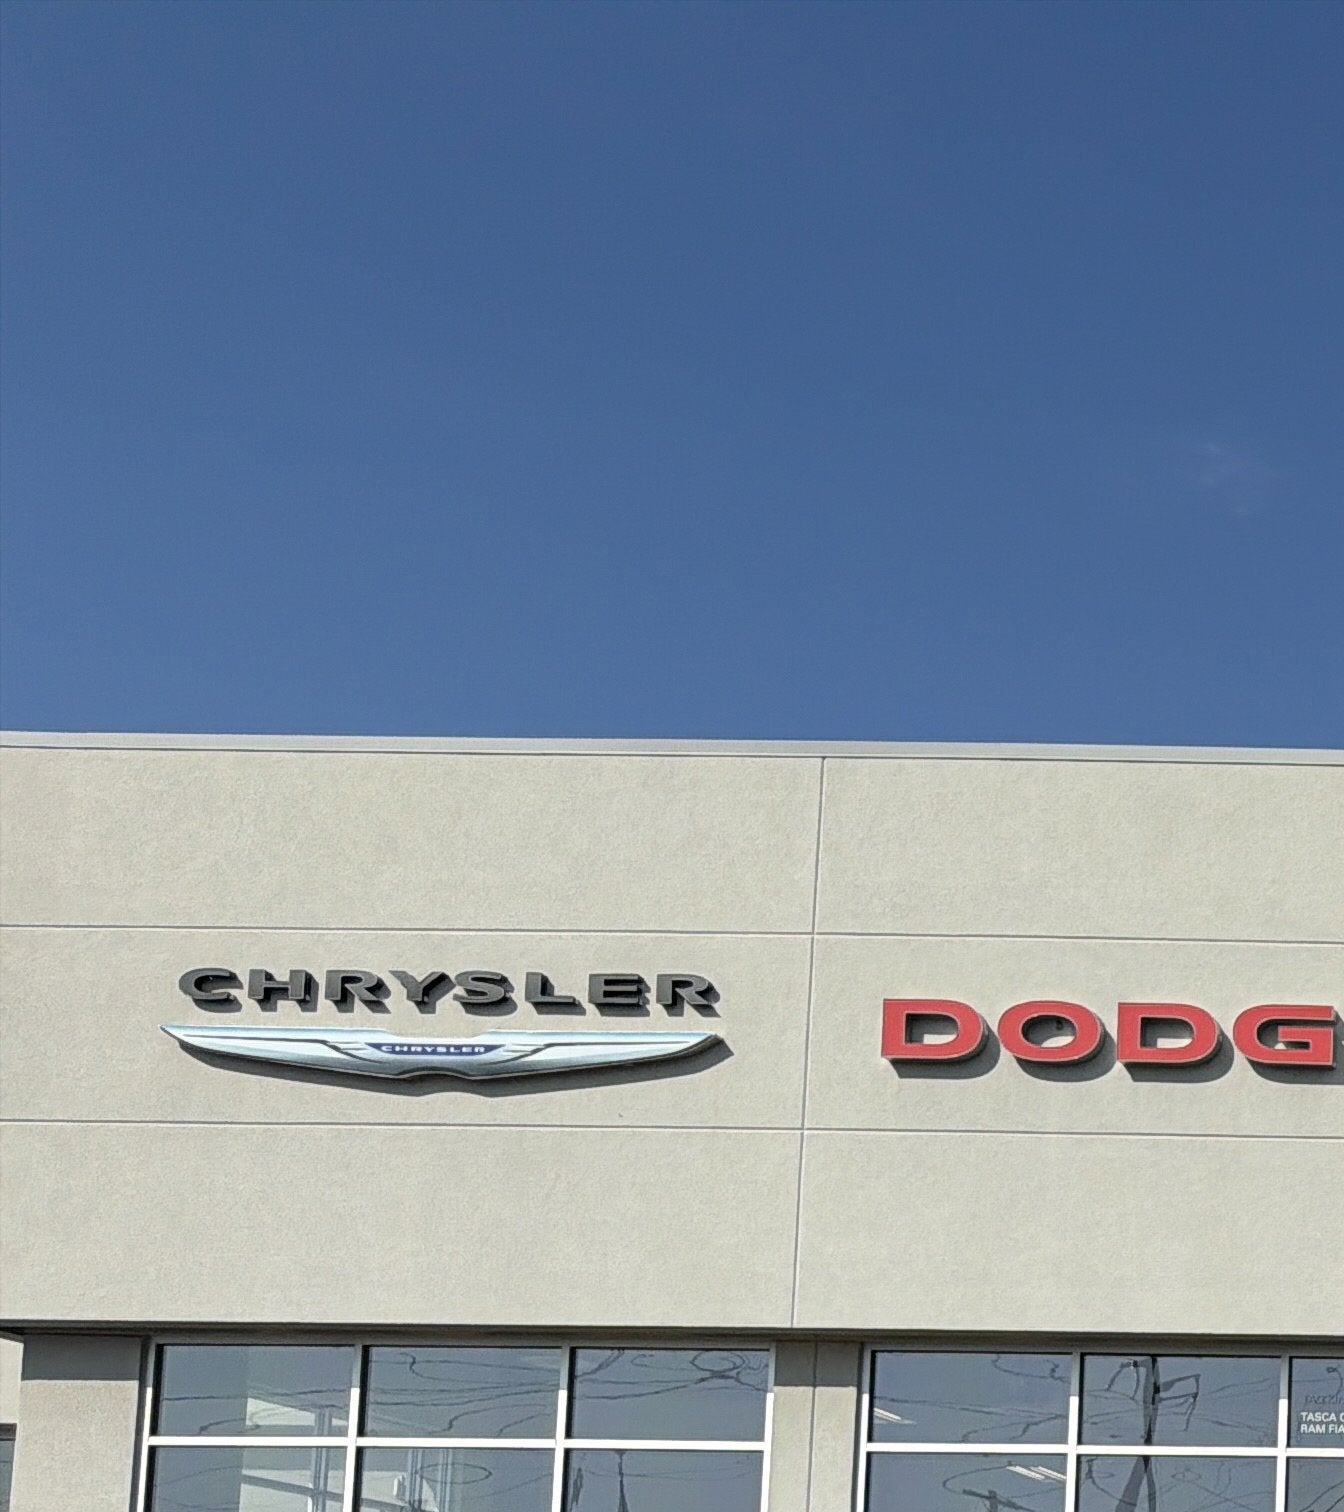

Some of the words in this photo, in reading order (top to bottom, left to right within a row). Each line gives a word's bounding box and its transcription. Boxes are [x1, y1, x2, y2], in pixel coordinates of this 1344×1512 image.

[178, 967, 719, 1012] CHRYSLER
[380, 1045, 486, 1054] CHRYSLER
[1300, 1412, 1337, 1423] TASCA
[1300, 1424, 1326, 1434] RAM
